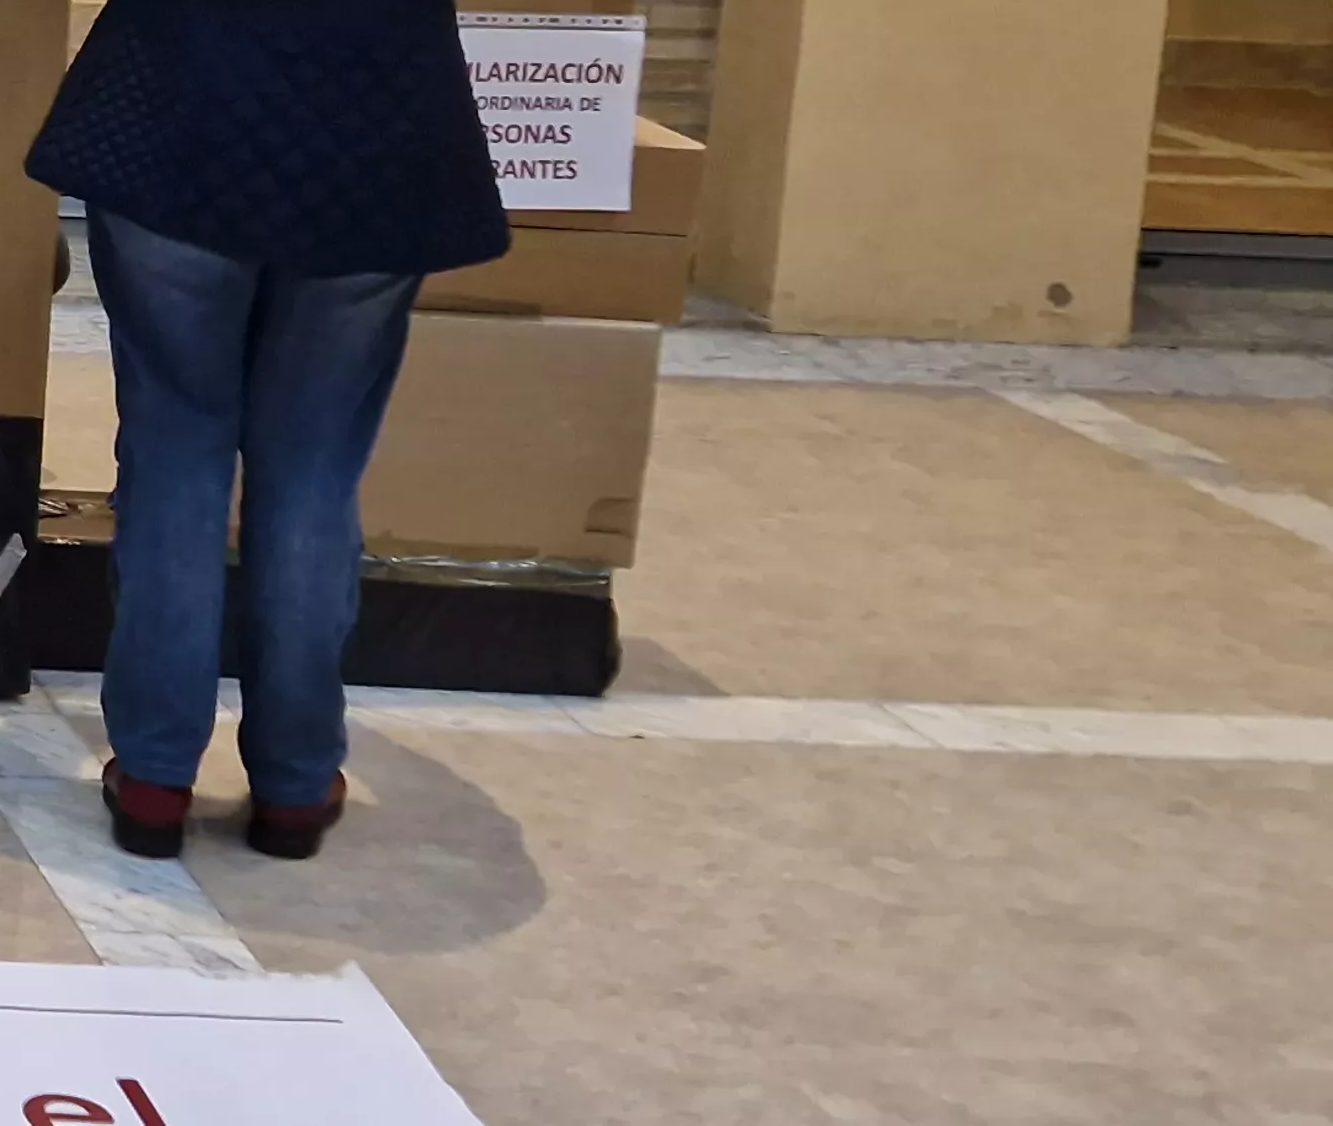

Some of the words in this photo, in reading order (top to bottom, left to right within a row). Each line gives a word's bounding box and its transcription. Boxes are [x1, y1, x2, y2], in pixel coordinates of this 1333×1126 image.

[467, 58, 625, 85] LARIZACIÓN
[476, 95, 573, 111] ORDINARIA
[579, 97, 602, 112] DE
[484, 123, 572, 144] SONAS
[491, 159, 578, 179] RANTES
